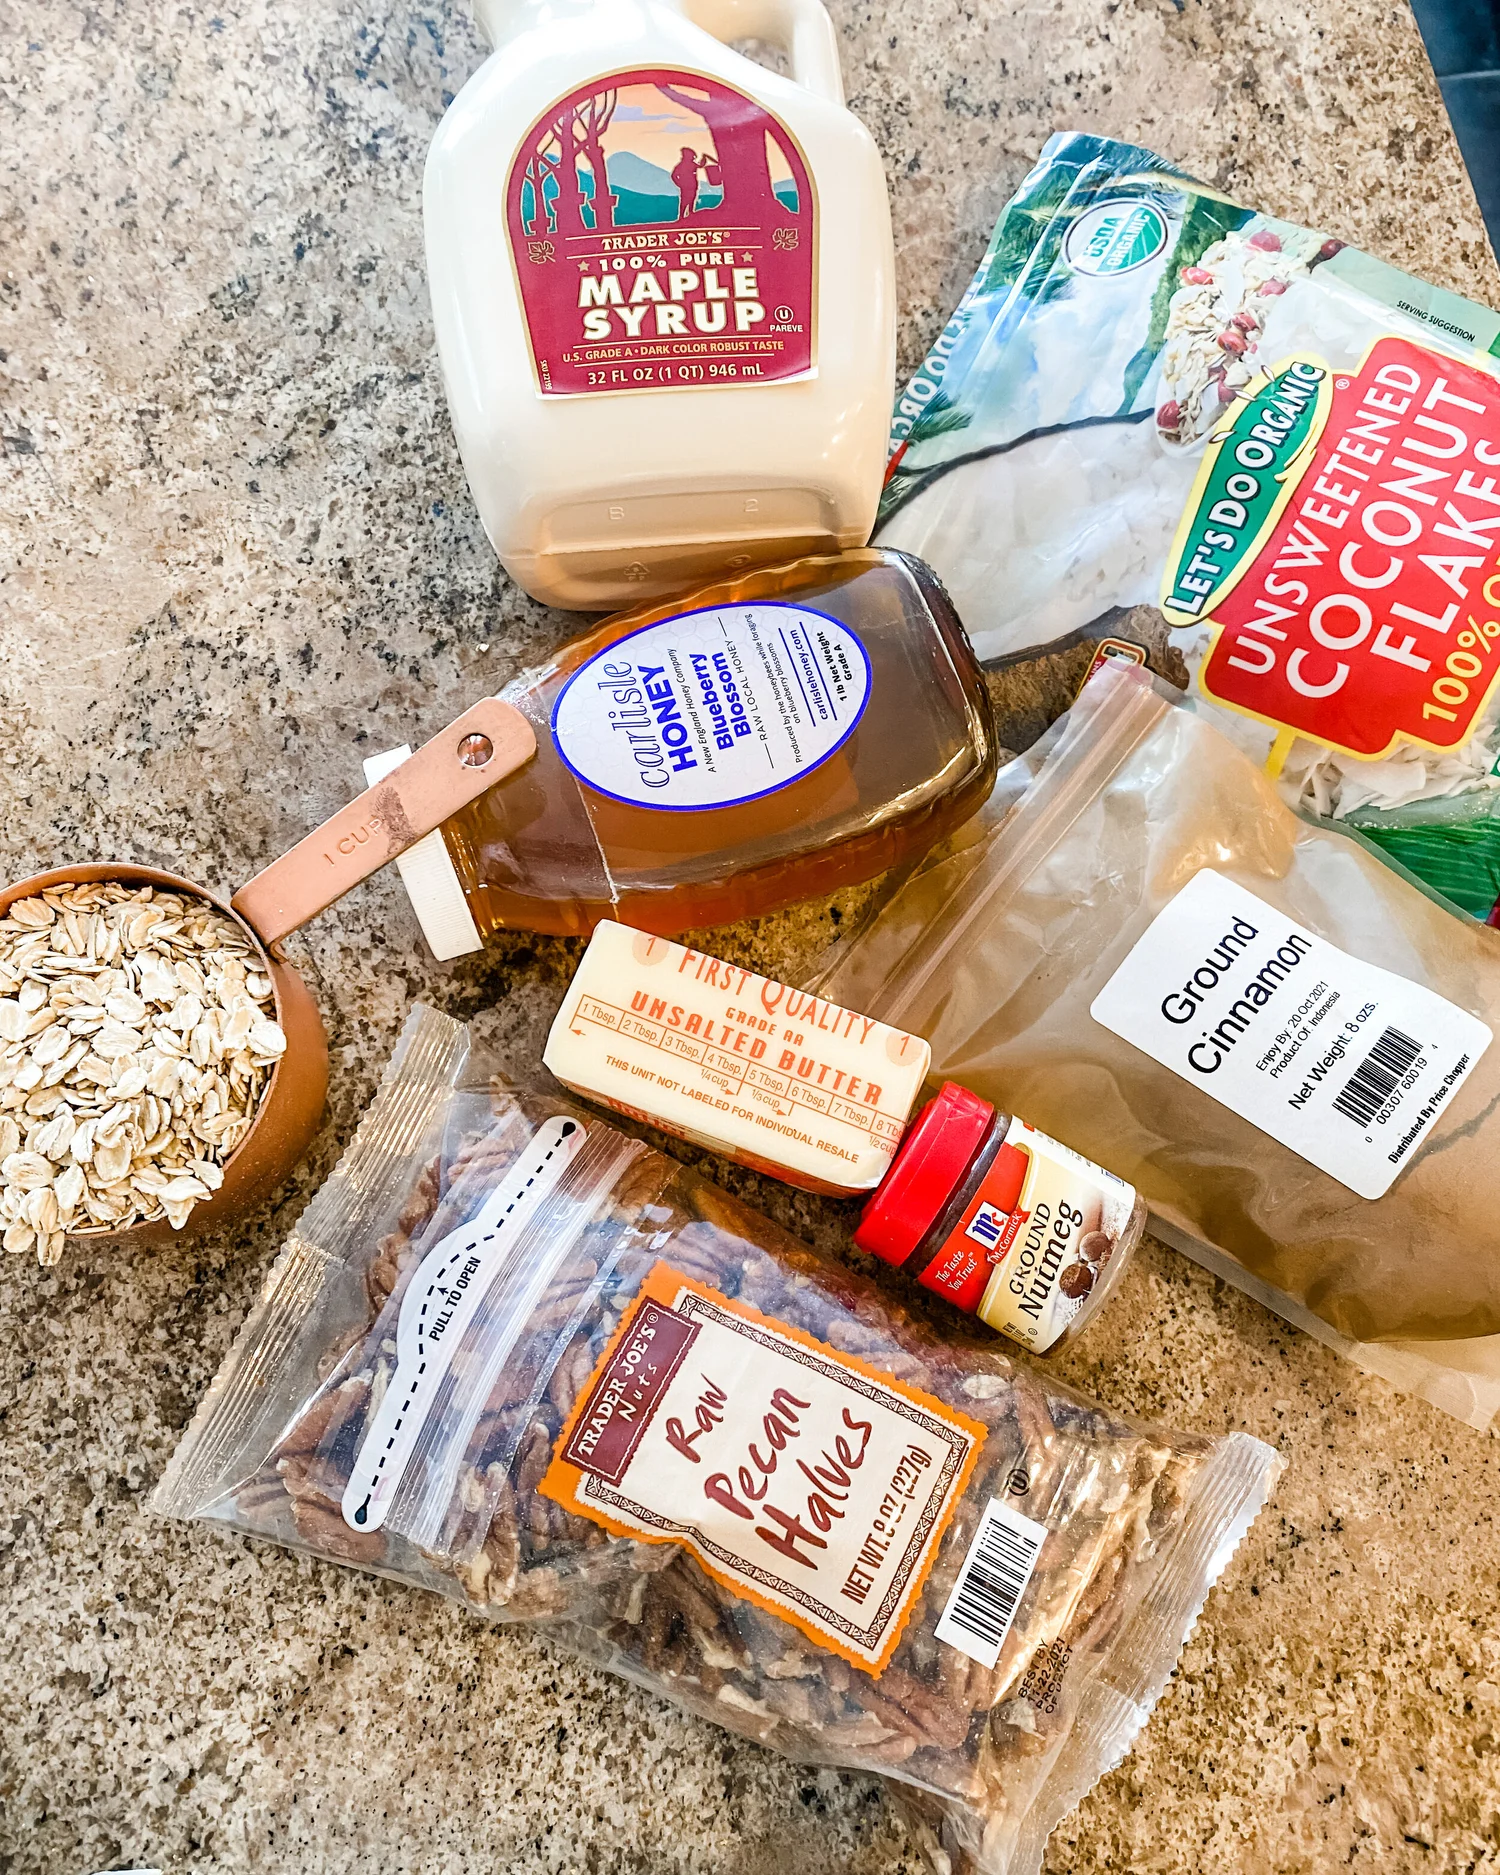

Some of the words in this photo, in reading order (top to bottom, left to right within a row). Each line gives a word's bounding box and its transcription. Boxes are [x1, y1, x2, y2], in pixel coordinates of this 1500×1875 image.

[602, 233, 669, 250] TRADER
[1083, 217, 1123, 258] USDA
[1107, 213, 1151, 266] ORGANIC
[600, 254, 667, 272] 100%
[680, 251, 735, 266] PURE
[578, 266, 760, 308] MAPLE
[582, 300, 767, 341] SYRUP
[770, 324, 803, 332] PAREVE
[1396, 300, 1428, 320] SERVING
[1428, 315, 1476, 342] SUGGESTION
[562, 352, 583, 362] U.S.
[585, 348, 622, 360] GRADE
[624, 347, 633, 356] A
[640, 344, 670, 355] DARK
[673, 343, 708, 353] COLOR
[710, 341, 750, 352] ROBUST
[753, 341, 784, 350] TASTE
[588, 371, 607, 385] 32
[611, 370, 628, 382] FL
[633, 367, 654, 381] OZ
[658, 366, 672, 382] (1
[679, 365, 704, 380] QT)
[709, 363, 737, 377] 946
[742, 363, 764, 376] mL
[743, 498, 759, 512] 2
[1164, 526, 1235, 616] LET'S
[1207, 471, 1261, 532] DO
[1236, 360, 1326, 473] ORGANIC
[609, 506, 625, 520] B
[1227, 363, 1422, 676] UNSWEETENED
[1286, 376, 1488, 699] COCONUT
[744, 613, 761, 641] foraging
[667, 648, 685, 683] Company
[724, 639, 744, 674] HONEY
[756, 641, 768, 661] while
[767, 642, 784, 676] blossoms
[817, 631, 834, 664] Weight
[763, 661, 782, 701] honeybees
[790, 629, 829, 720] carlislehoney.com
[829, 664, 842, 684] Net
[837, 653, 853, 681] Grade
[1422, 614, 1500, 723] 100%
[681, 685, 695, 710] Honey
[689, 653, 735, 750] Blueberry
[711, 652, 752, 738] Blossom
[740, 677, 758, 711] LOCAL
[777, 701, 787, 714] the
[780, 676, 796, 713] blueberry
[836, 685, 846, 695] lb
[597, 661, 670, 788] carlisle
[637, 665, 698, 772] HONEY
[688, 711, 707, 744] England
[752, 715, 768, 741] RAW
[782, 715, 791, 725] by
[792, 711, 801, 724] on
[703, 746, 714, 764] New
[786, 725, 802, 763] Produced
[707, 765, 717, 773] A
[336, 818, 384, 857] CUP
[646, 936, 658, 957] 1
[1161, 916, 1260, 1024] Ground
[583, 1003, 589, 1013] 1
[591, 1005, 616, 1025] Tbsp.
[678, 948, 753, 996] FIRST
[760, 978, 876, 1045] QUALITY
[1187, 934, 1313, 1074] Cinnamon
[622, 1019, 632, 1030] 2
[632, 1021, 658, 1042] Tbsp.
[725, 1007, 778, 1036] GRADE
[783, 1029, 805, 1047] AA
[1256, 1043, 1282, 1071] Enjoy
[1275, 1027, 1293, 1045] By:
[1287, 1013, 1302, 1029] 20
[1297, 998, 1315, 1015] Oct
[1309, 980, 1329, 1001] 2021
[1269, 1040, 1303, 1078] Product
[1297, 1026, 1314, 1041] Of:
[1308, 991, 1341, 1026] Indonesia
[630, 990, 768, 1059] UNSALTED
[778, 1049, 883, 1106] BUTTER
[665, 1036, 674, 1047] 3
[674, 1038, 700, 1059] Tbsp.
[707, 1053, 715, 1063] 4
[716, 1055, 742, 1075] Tbsp.
[900, 1035, 911, 1057] 1
[1288, 1080, 1316, 1110] Net
[1307, 1032, 1353, 1081] Weight:
[1344, 1022, 1360, 1033] 8
[1355, 1002, 1379, 1022] ozs.
[700, 1068, 711, 1081] 1/4
[711, 1073, 729, 1088] cup
[749, 1069, 757, 1080] 5
[759, 1071, 784, 1092] Tbsp.
[1375, 1089, 1405, 1125] 00307
[1401, 1057, 1428, 1090] 60019
[606, 1055, 630, 1071] THIS
[631, 1065, 657, 1082] UNIT
[656, 1075, 680, 1091] NOT
[681, 1086, 730, 1111] LABELED
[731, 1105, 754, 1121] FOR
[755, 1115, 813, 1146] INDIVIDUAL
[816, 1139, 859, 1164] RESALE
[751, 1088, 762, 1102] 1/3
[762, 1094, 780, 1109] cup
[791, 1086, 800, 1097] 6
[801, 1088, 826, 1109] Tbsp.
[834, 1102, 843, 1113] 7
[843, 1105, 869, 1126] Tbsp.
[1388, 1116, 1427, 1164] Distributed
[1420, 1105, 1436, 1119] By
[1428, 1085, 1448, 1107] Price
[1443, 1053, 1470, 1086] Chopper
[869, 1135, 880, 1149] 1/2
[880, 1142, 897, 1159] cup
[876, 1119, 885, 1131] 8
[886, 1122, 905, 1139] Tbs
[1364, 1136, 1373, 1144] 0
[993, 1213, 1023, 1261] McCormick
[1009, 1203, 1051, 1295] GROUND
[935, 1270, 951, 1283] The
[943, 1250, 965, 1272] Taste
[947, 1279, 964, 1291] You
[956, 1257, 978, 1281] Trust
[1018, 1199, 1084, 1321] Nutmeg
[428, 1306, 454, 1342] PULL
[449, 1285, 463, 1307] TO
[459, 1256, 482, 1290] OPEN
[577, 1377, 628, 1456] TRADER
[620, 1323, 657, 1377] JOE'S
[618, 1363, 657, 1422] Nuts
[665, 1373, 728, 1463] Raw
[704, 1387, 812, 1521] Pecan
[890, 1444, 933, 1500] (227g)
[755, 1406, 873, 1571] Halves
[857, 1532, 891, 1569] WT.
[840, 1563, 875, 1605] NET
[1018, 1659, 1039, 1698] BEST
[1036, 1638, 1048, 1659] BY
[1027, 1637, 1065, 1702] 11-22-2021
[1045, 1696, 1058, 1714] OF
